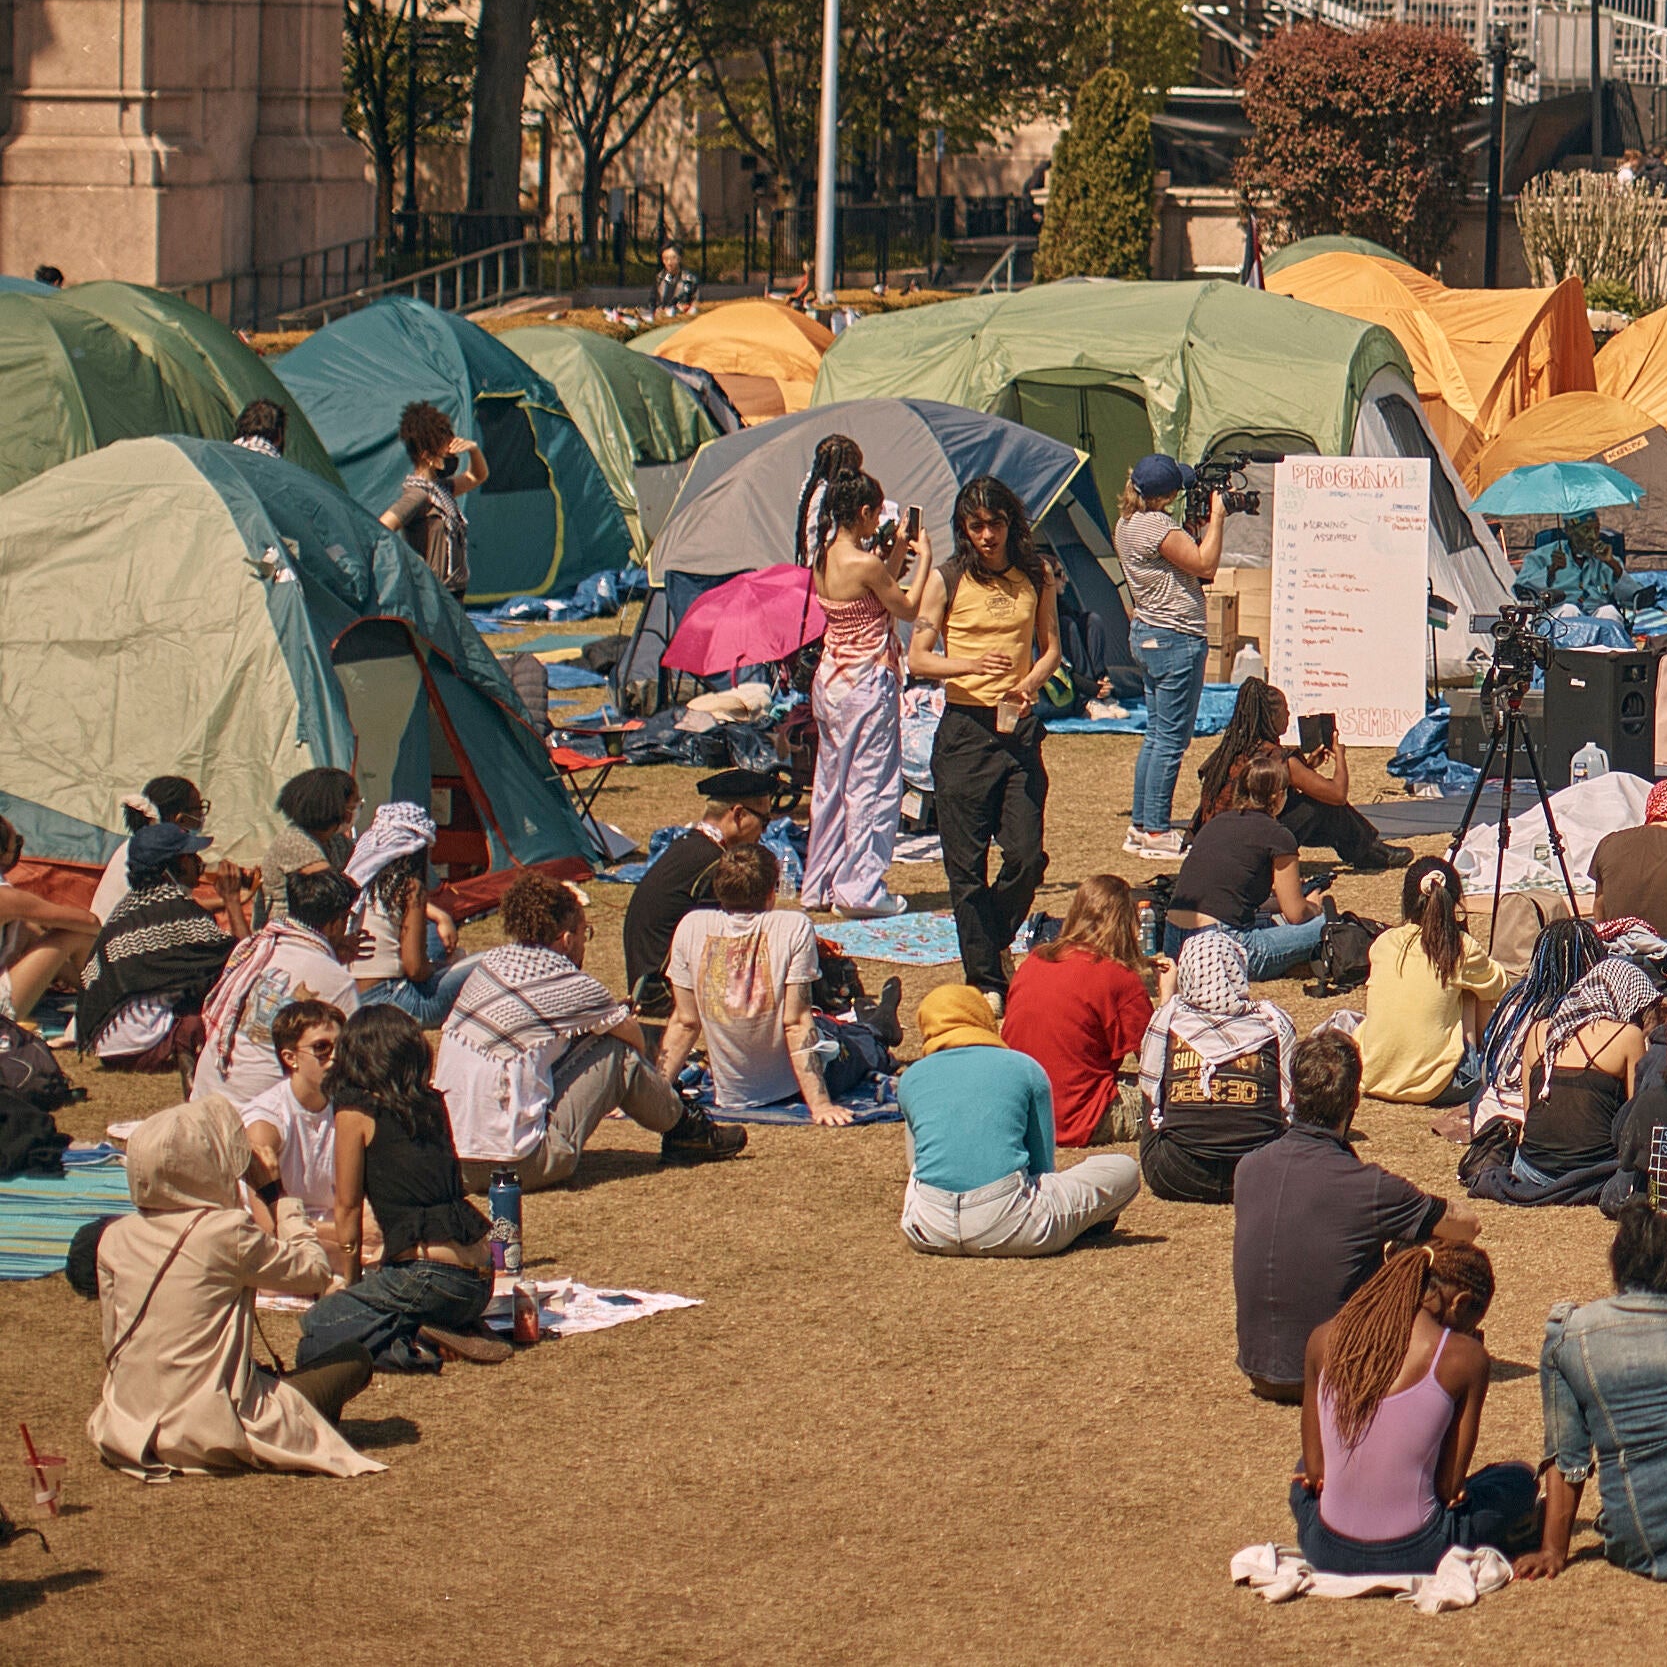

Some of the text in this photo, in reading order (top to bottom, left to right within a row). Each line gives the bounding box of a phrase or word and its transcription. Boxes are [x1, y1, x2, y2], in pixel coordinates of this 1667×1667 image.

[1292, 463, 1404, 489] PROGRAM
[1303, 520, 1348, 530] MORNING
[1313, 533, 1358, 542] ASSEMBLY
